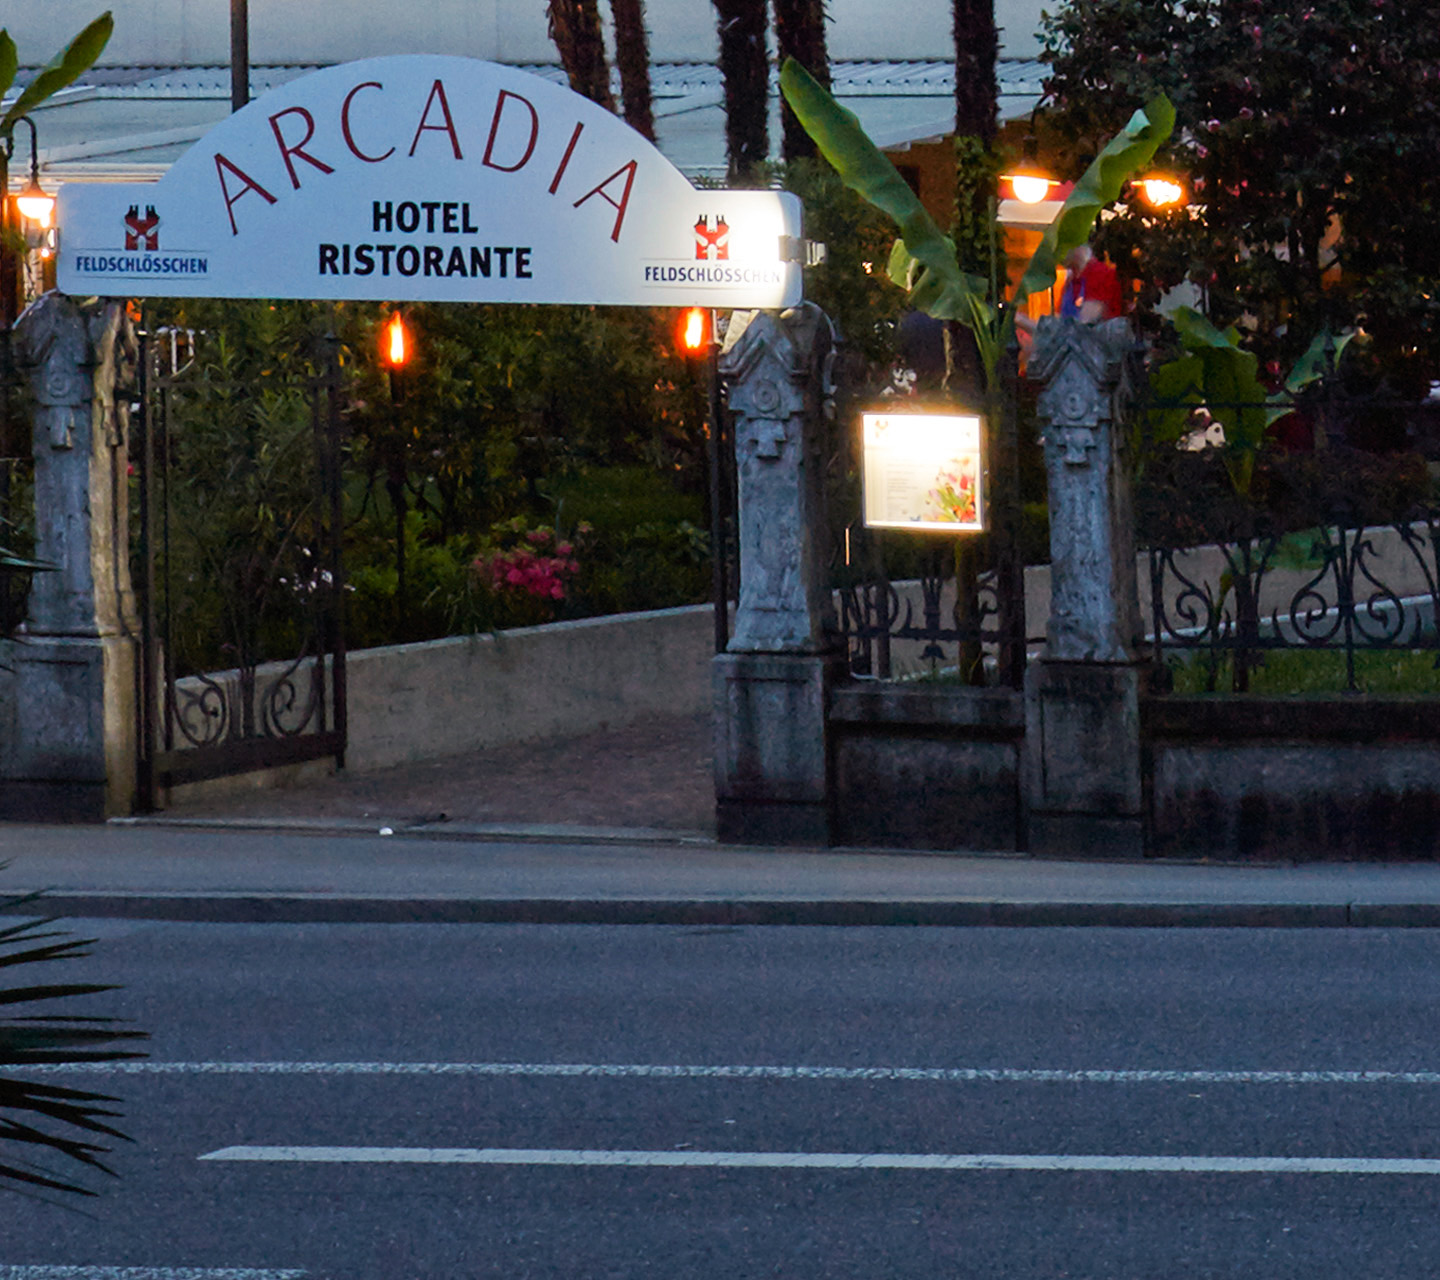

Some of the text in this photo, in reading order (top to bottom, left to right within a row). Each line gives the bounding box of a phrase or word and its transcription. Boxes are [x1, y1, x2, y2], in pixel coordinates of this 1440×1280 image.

[214, 79, 637, 243] ARCADIA
[372, 201, 478, 234] HOTEL
[76, 254, 208, 273] FELDSCHLÖSSCHEN
[318, 243, 533, 278] RISTORANTE
[645, 264, 780, 283] FELDSCHLÖSSCHEN
